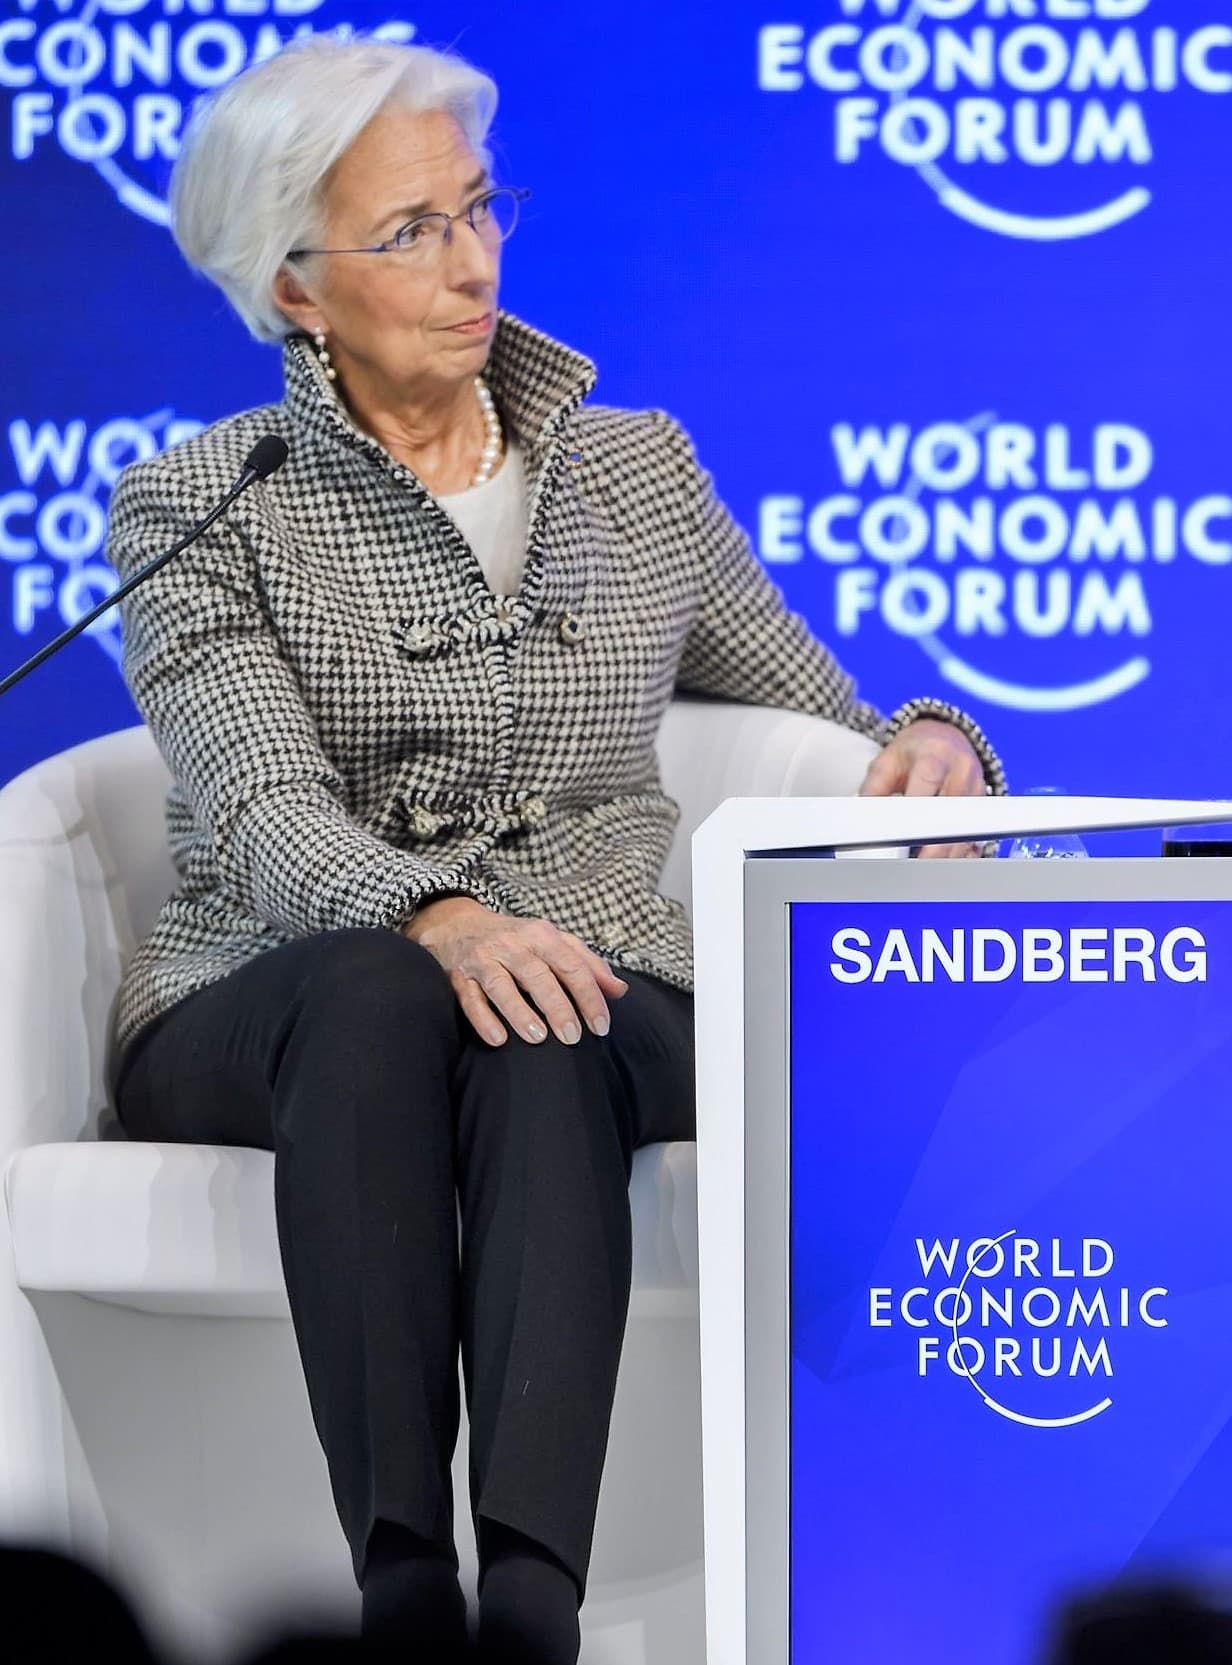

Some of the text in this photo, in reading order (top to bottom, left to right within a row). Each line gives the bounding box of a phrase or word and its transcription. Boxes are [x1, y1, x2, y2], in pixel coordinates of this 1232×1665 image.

[0, 19, 416, 88] CONO
[12, 93, 205, 161] FOR
[834, 97, 1152, 166] FORUM
[831, 422, 1152, 491] WORLD
[835, 568, 1151, 637] FORUM
[829, 927, 1207, 984] SANDBERG
[915, 1237, 1115, 1278] WORLD
[869, 1287, 1169, 1328] ECONOMIC
[918, 1337, 1114, 1377] FORUM
